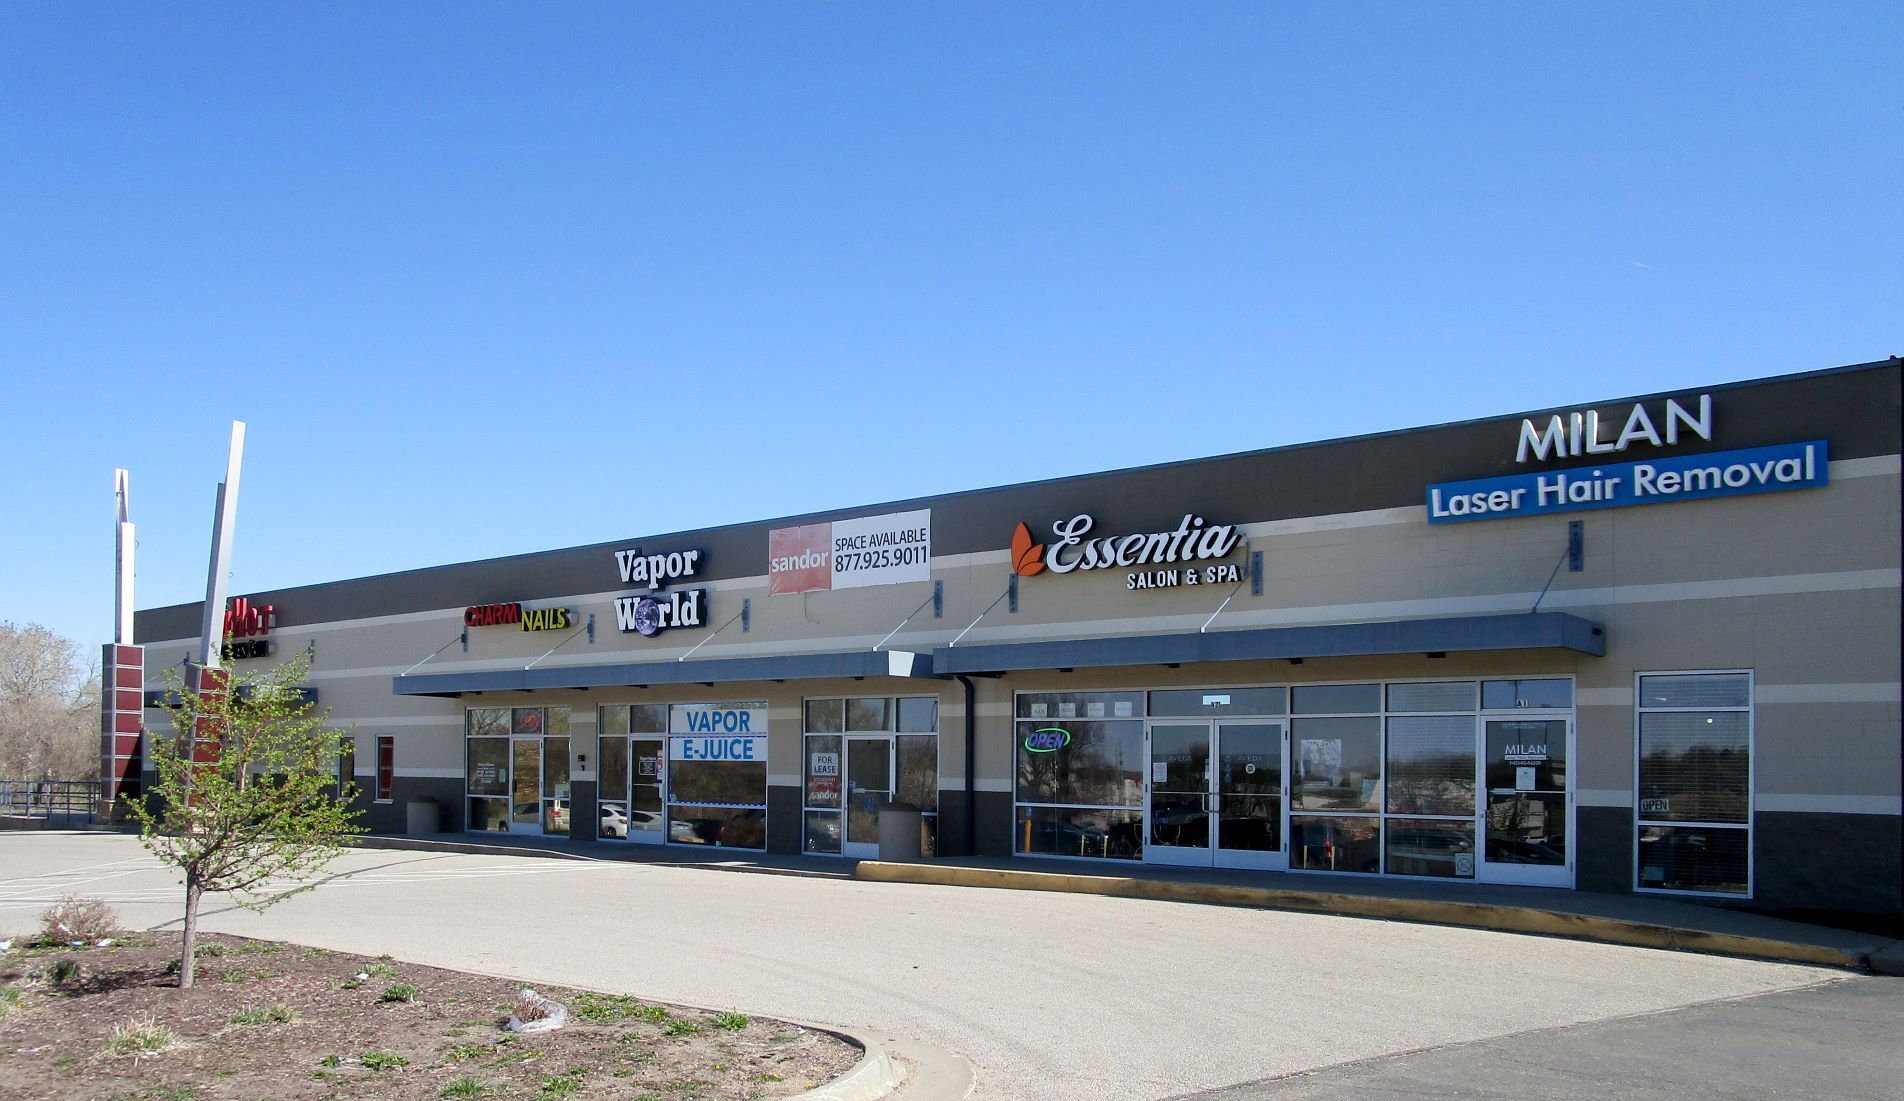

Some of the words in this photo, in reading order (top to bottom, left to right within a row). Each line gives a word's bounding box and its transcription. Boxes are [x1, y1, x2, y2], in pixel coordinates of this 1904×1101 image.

[1516, 394, 1712, 463] MILAN
[1431, 487, 1526, 519] Laser
[1537, 469, 1622, 508] Hair
[1633, 444, 1816, 498] Removal
[835, 535, 867, 552] SPACE
[869, 527, 927, 548] AVAILABLE
[1046, 513, 1239, 574] Essentia
[614, 549, 698, 590] Vapor
[771, 549, 829, 573] sandor
[835, 545, 928, 573] 877.925.9011
[1126, 569, 1178, 590] SALON
[1186, 568, 1198, 585] &
[1206, 565, 1239, 584] SPA
[464, 602, 520, 627] CHARM
[521, 607, 569, 632] NAILS
[686, 710, 751, 733] VAPOR
[683, 738, 754, 760] E-JUICE
[1028, 732, 1065, 749] OPEN
[1504, 744, 1547, 755] MILAN
[814, 765, 836, 774] LEASE
[817, 756, 833, 764] FOR
[811, 789, 839, 800] sandor
[1642, 799, 1669, 810] OPEN
